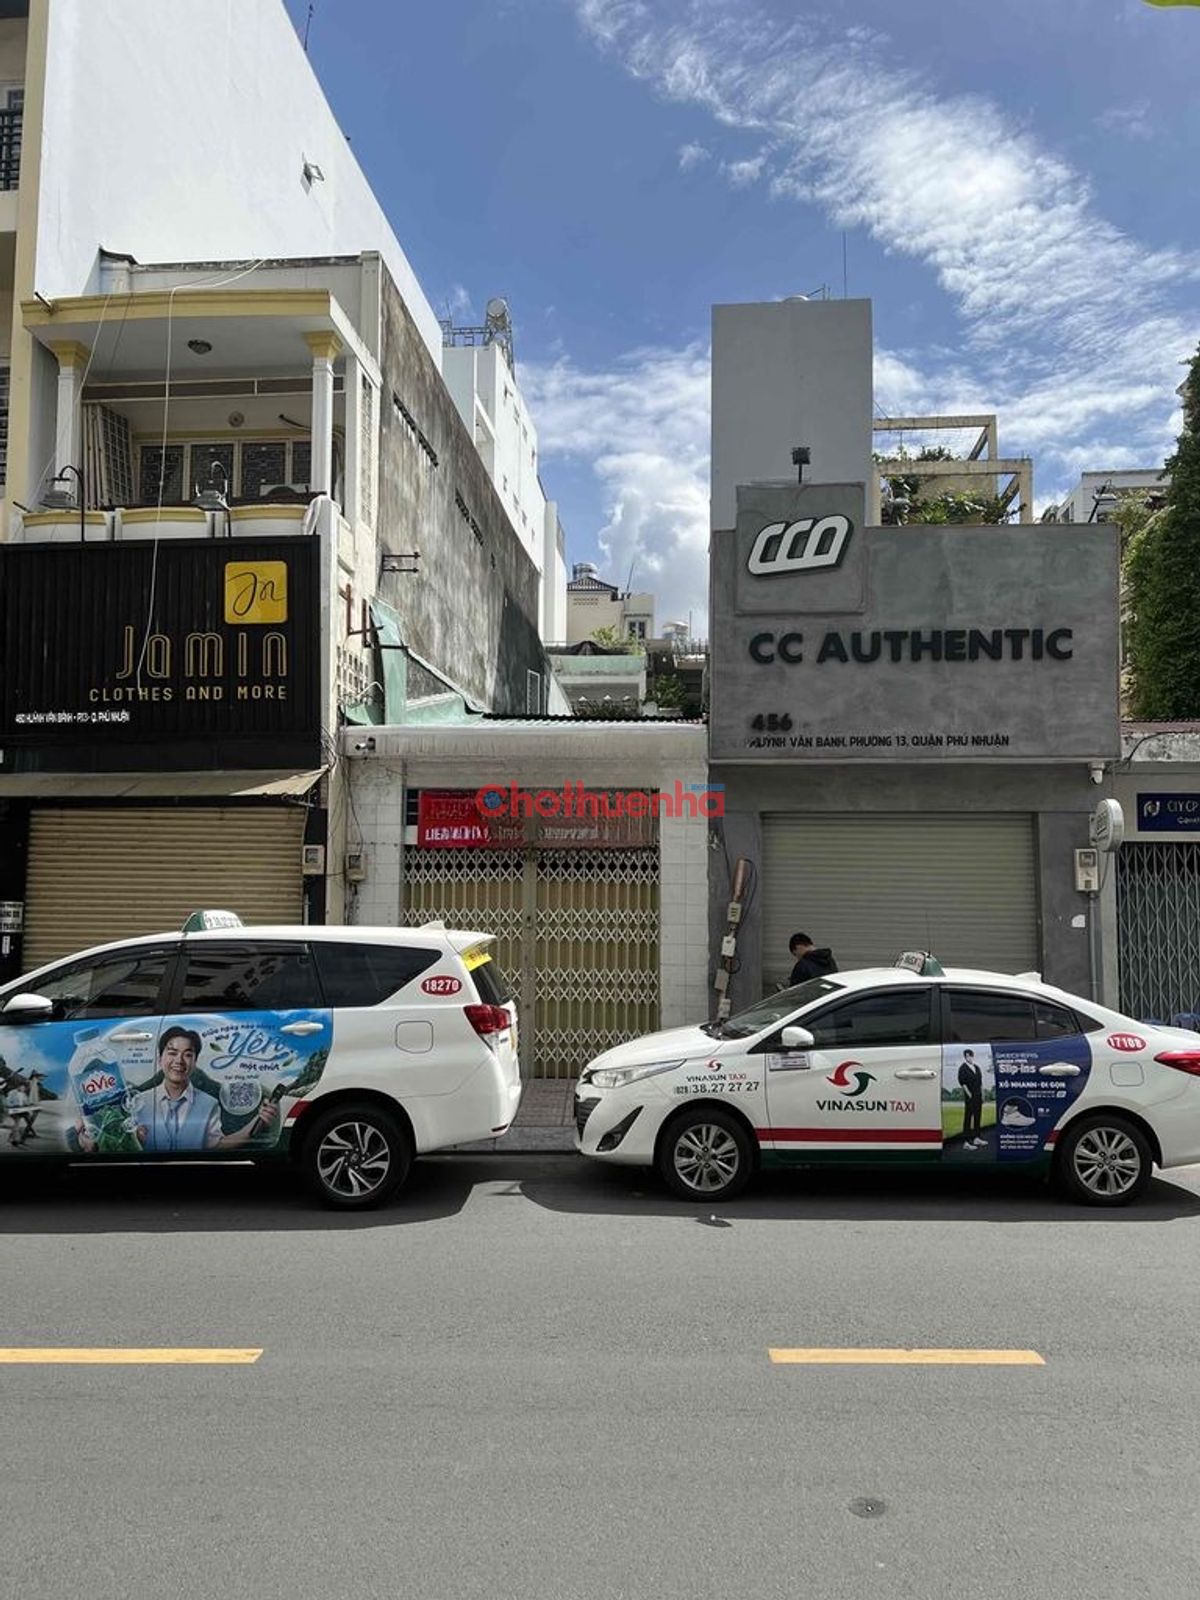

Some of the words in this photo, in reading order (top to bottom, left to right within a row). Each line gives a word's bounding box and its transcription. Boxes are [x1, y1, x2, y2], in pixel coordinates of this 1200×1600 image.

[748, 631, 803, 665] CC
[816, 627, 1073, 664] AUTHENTIC
[89, 687, 173, 702] CLOTHES
[185, 686, 223, 701] AND
[237, 684, 287, 700] MORE
[751, 712, 793, 732] 456
[425, 979, 459, 992] 18270
[686, 1074, 726, 1083] VINASUN
[728, 1073, 747, 1081] TAXI
[728, 1082, 742, 1092] 27
[745, 1081, 760, 1092] 27
[816, 1100, 887, 1112] VINASUN
[890, 1101, 915, 1112] TAXI
